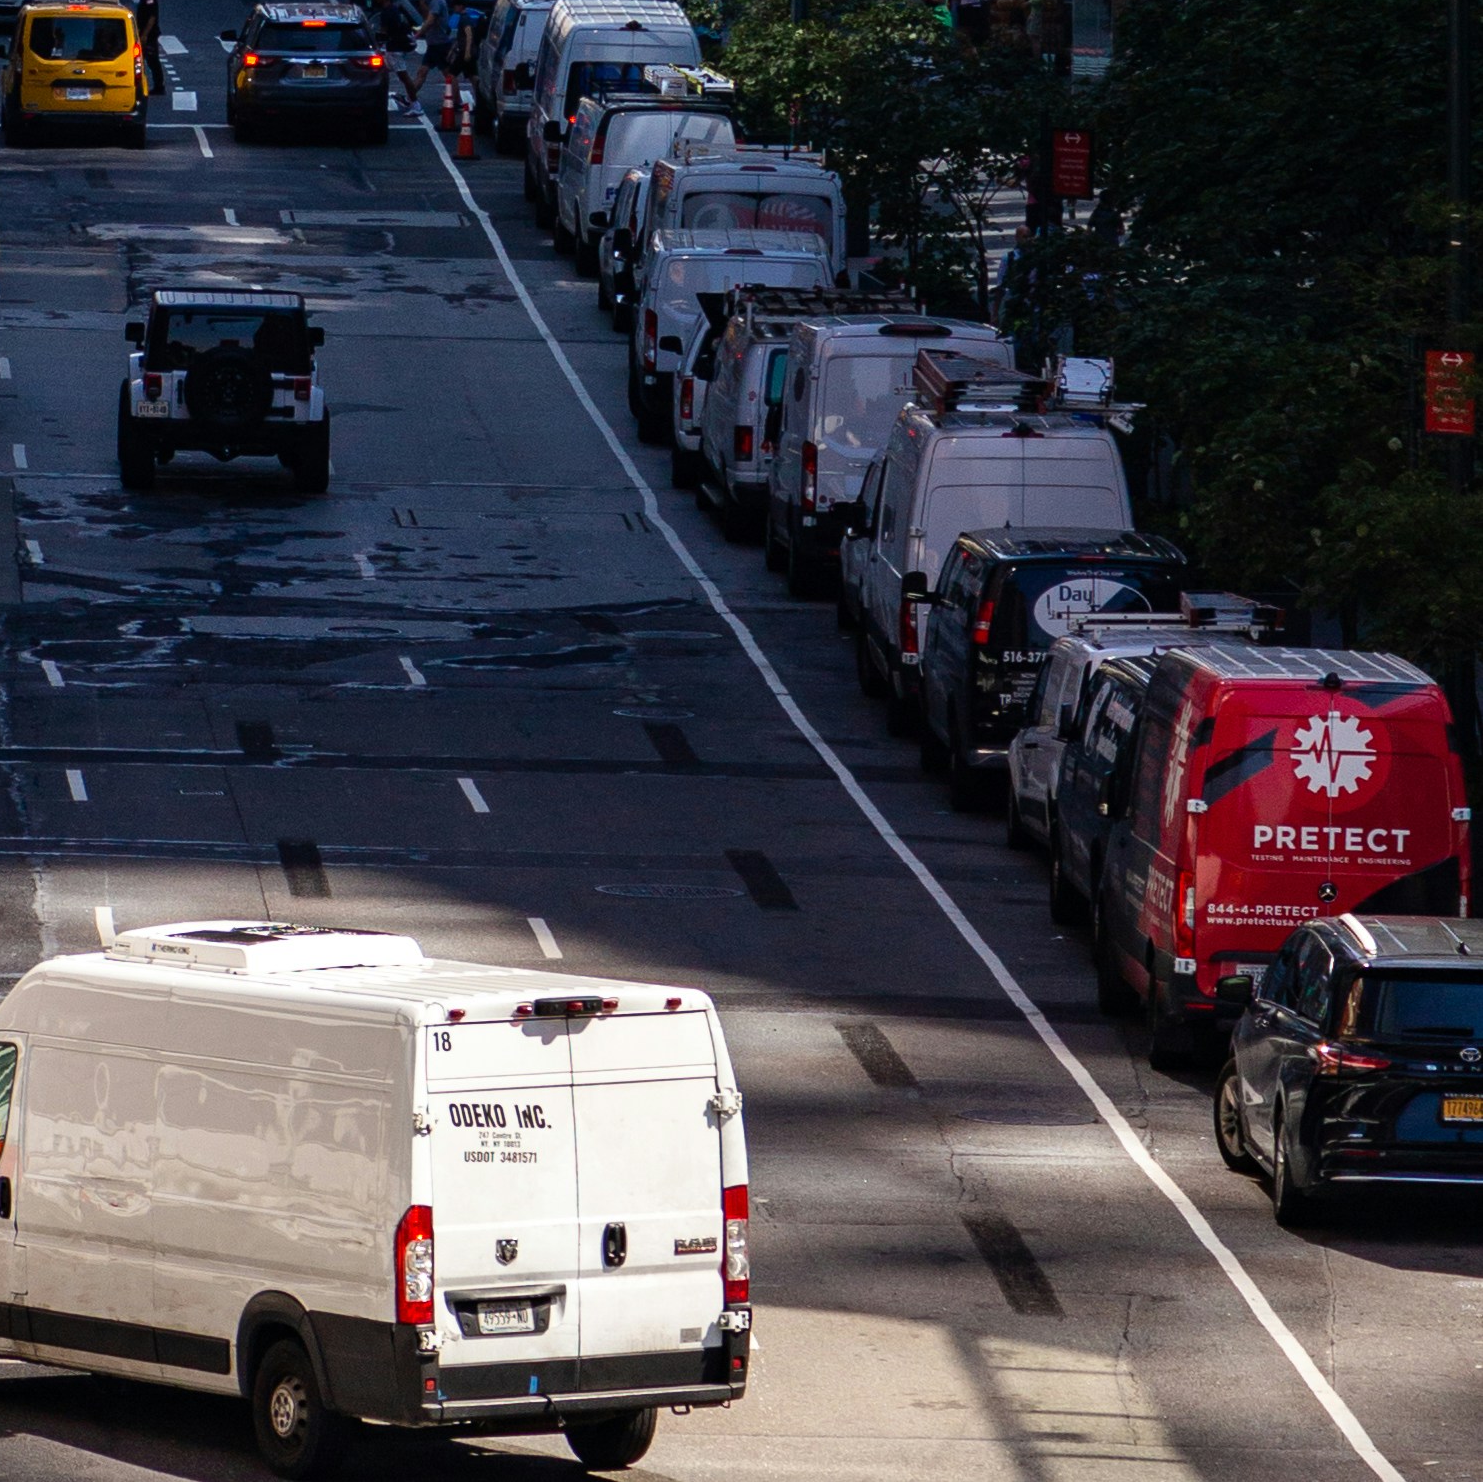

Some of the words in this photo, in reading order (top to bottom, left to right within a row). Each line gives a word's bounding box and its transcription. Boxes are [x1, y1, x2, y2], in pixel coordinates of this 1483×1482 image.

[1059, 585, 1093, 604] Day
[1253, 824, 1411, 853] PRETECT
[1251, 853, 1285, 862] TESTING
[1292, 855, 1350, 864] MAINTENANCE
[1357, 857, 1412, 866] ENGINEERING
[1207, 903, 1319, 917] 844-4-PRETECT
[433, 1031, 452, 1051] 18
[449, 1103, 507, 1128] ODEKO
[514, 1104, 552, 1129] INC.
[464, 1151, 495, 1163] USDOT
[500, 1151, 538, 1164] 3481571
